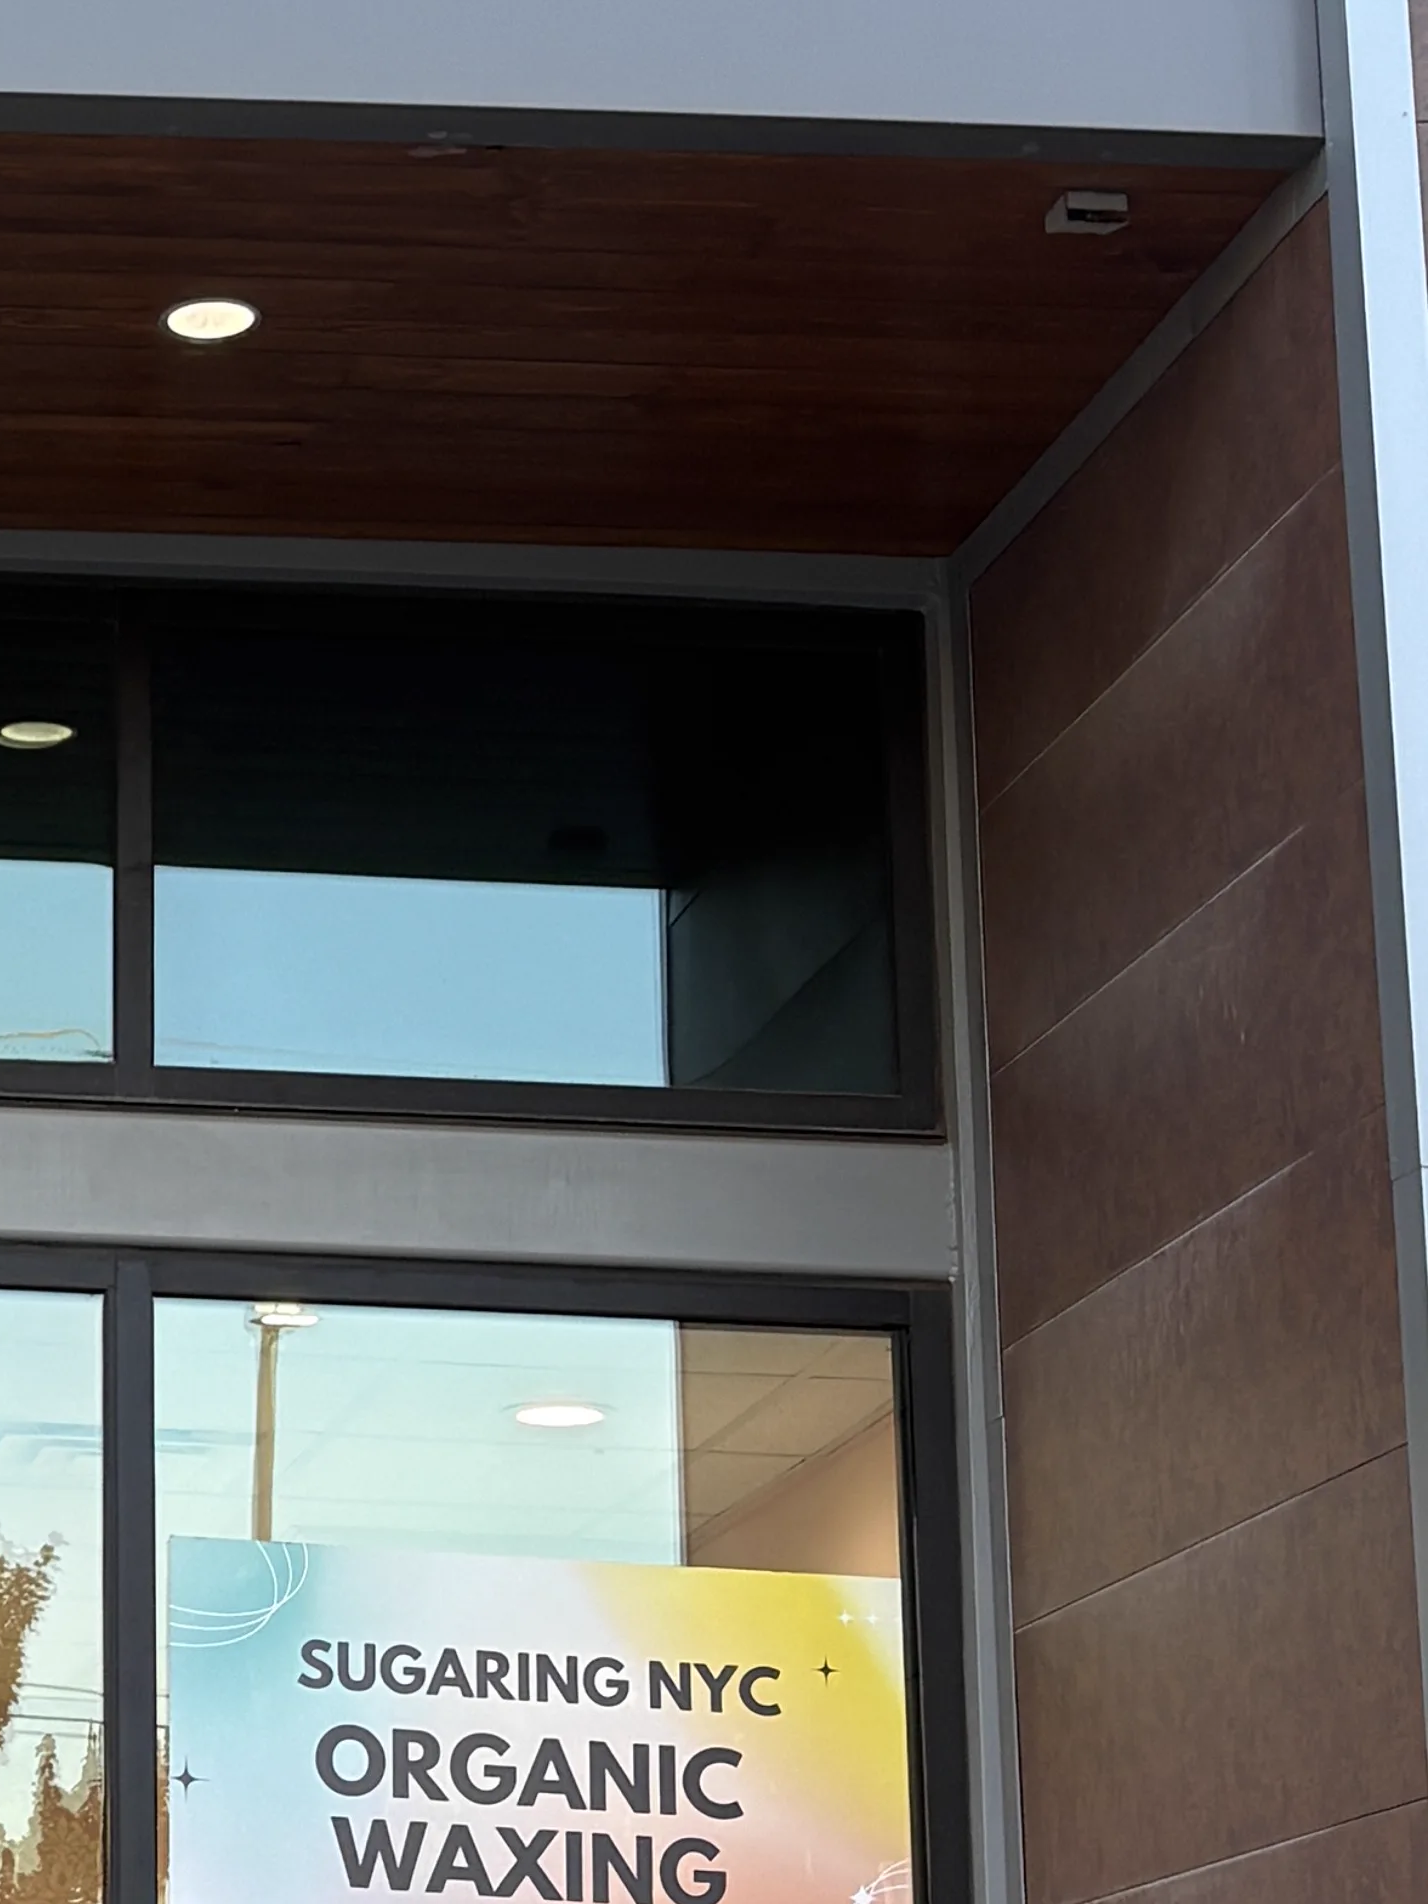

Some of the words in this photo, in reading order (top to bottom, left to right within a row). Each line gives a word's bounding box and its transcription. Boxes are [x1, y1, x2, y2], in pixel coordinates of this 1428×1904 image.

[295, 1637, 629, 1709] SUGARING
[648, 1659, 782, 1717] NYC
[314, 1723, 745, 1819] ORGANIC
